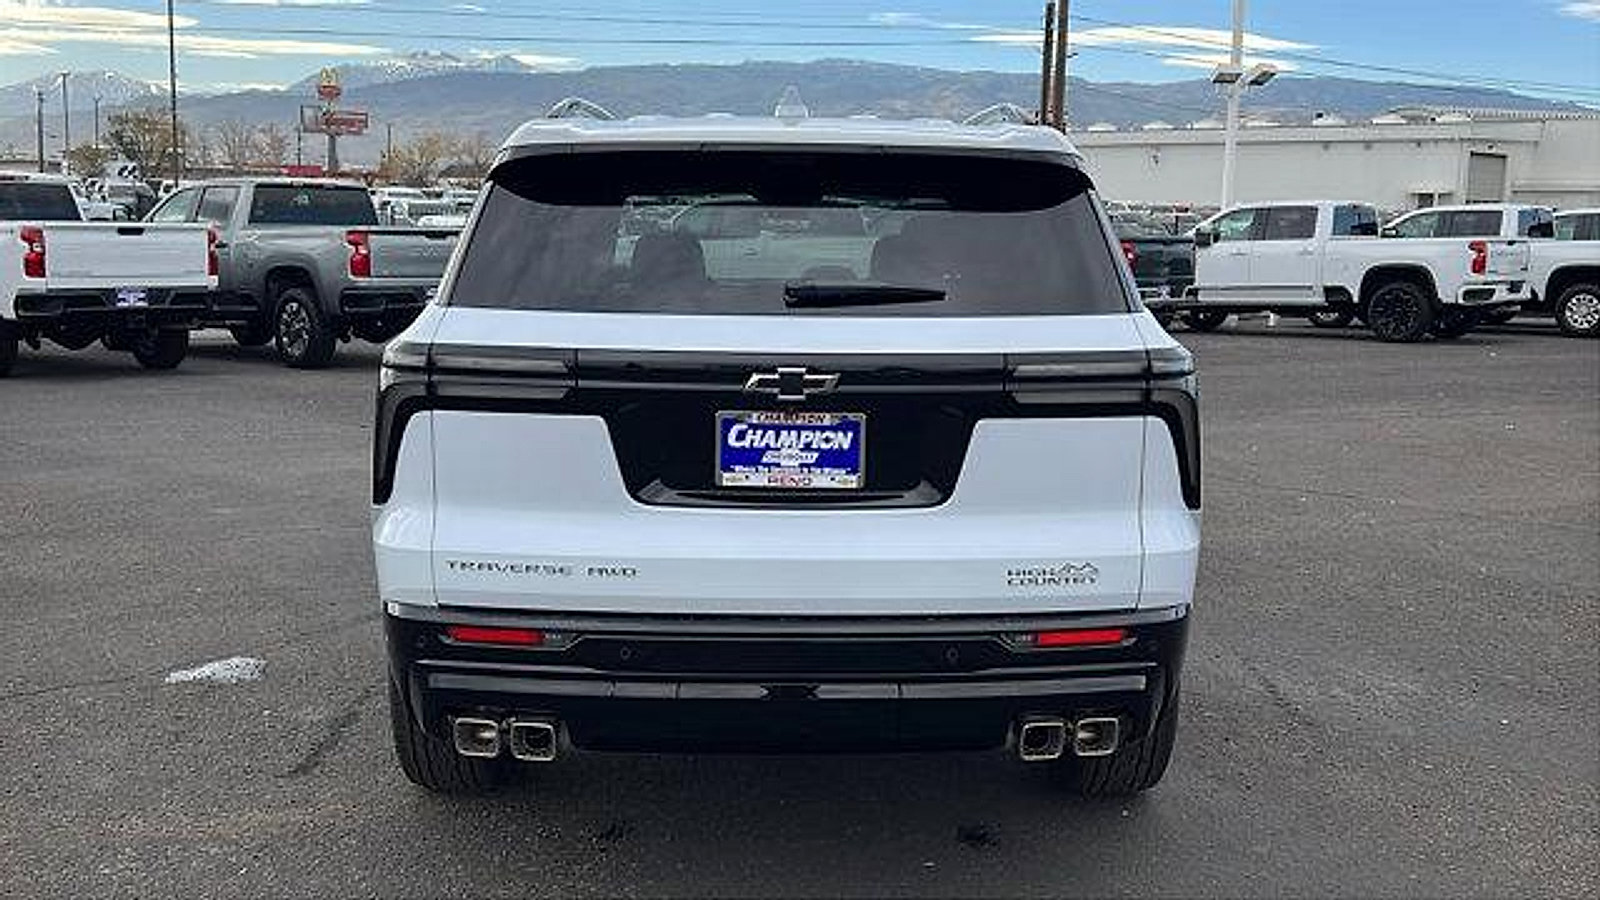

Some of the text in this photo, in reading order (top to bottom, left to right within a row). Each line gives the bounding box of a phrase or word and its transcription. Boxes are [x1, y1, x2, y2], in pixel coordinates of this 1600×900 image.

[446, 560, 637, 578] TRAVERSE AWD
[1007, 569, 1055, 577] HIGH
[1007, 577, 1097, 586] COUNTRY
